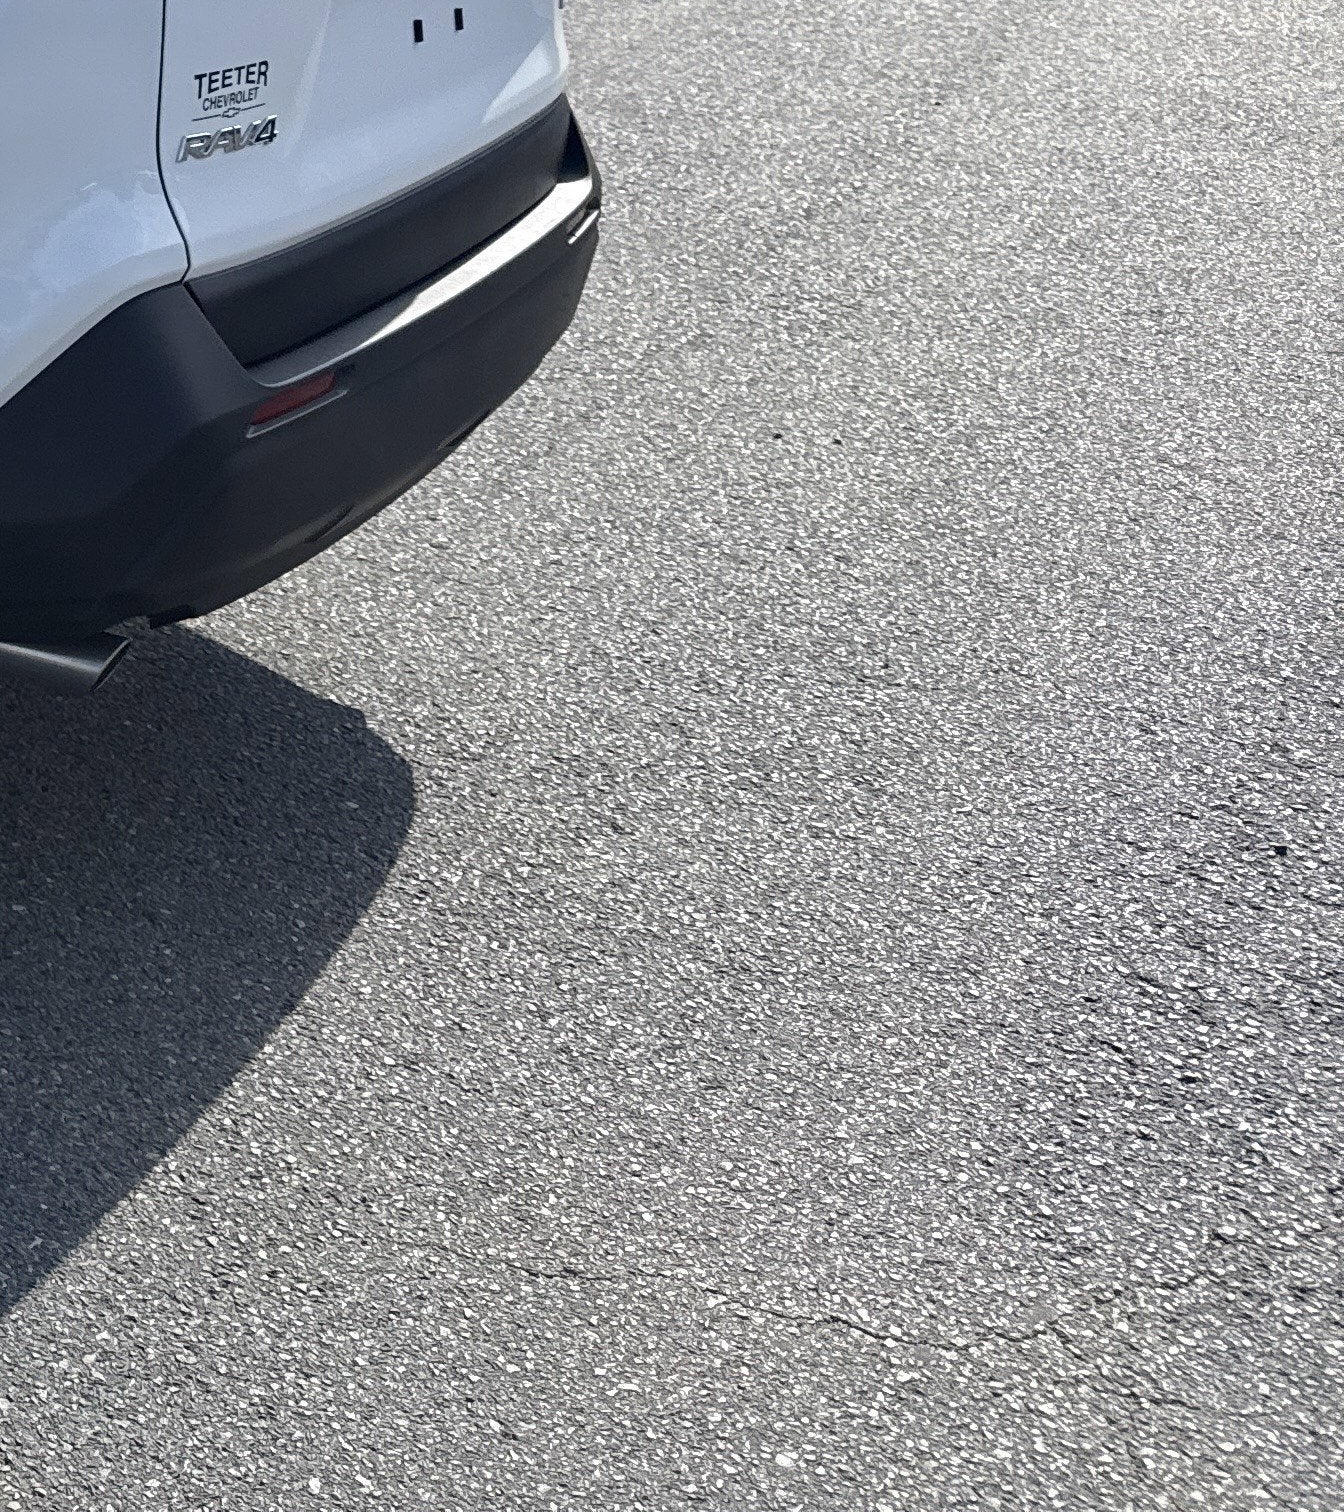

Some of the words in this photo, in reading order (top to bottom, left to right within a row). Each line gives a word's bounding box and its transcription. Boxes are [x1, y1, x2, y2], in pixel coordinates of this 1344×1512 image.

[194, 60, 269, 99] TEETER
[202, 86, 260, 111] CHEVROLET
[175, 115, 278, 163] RAV4
